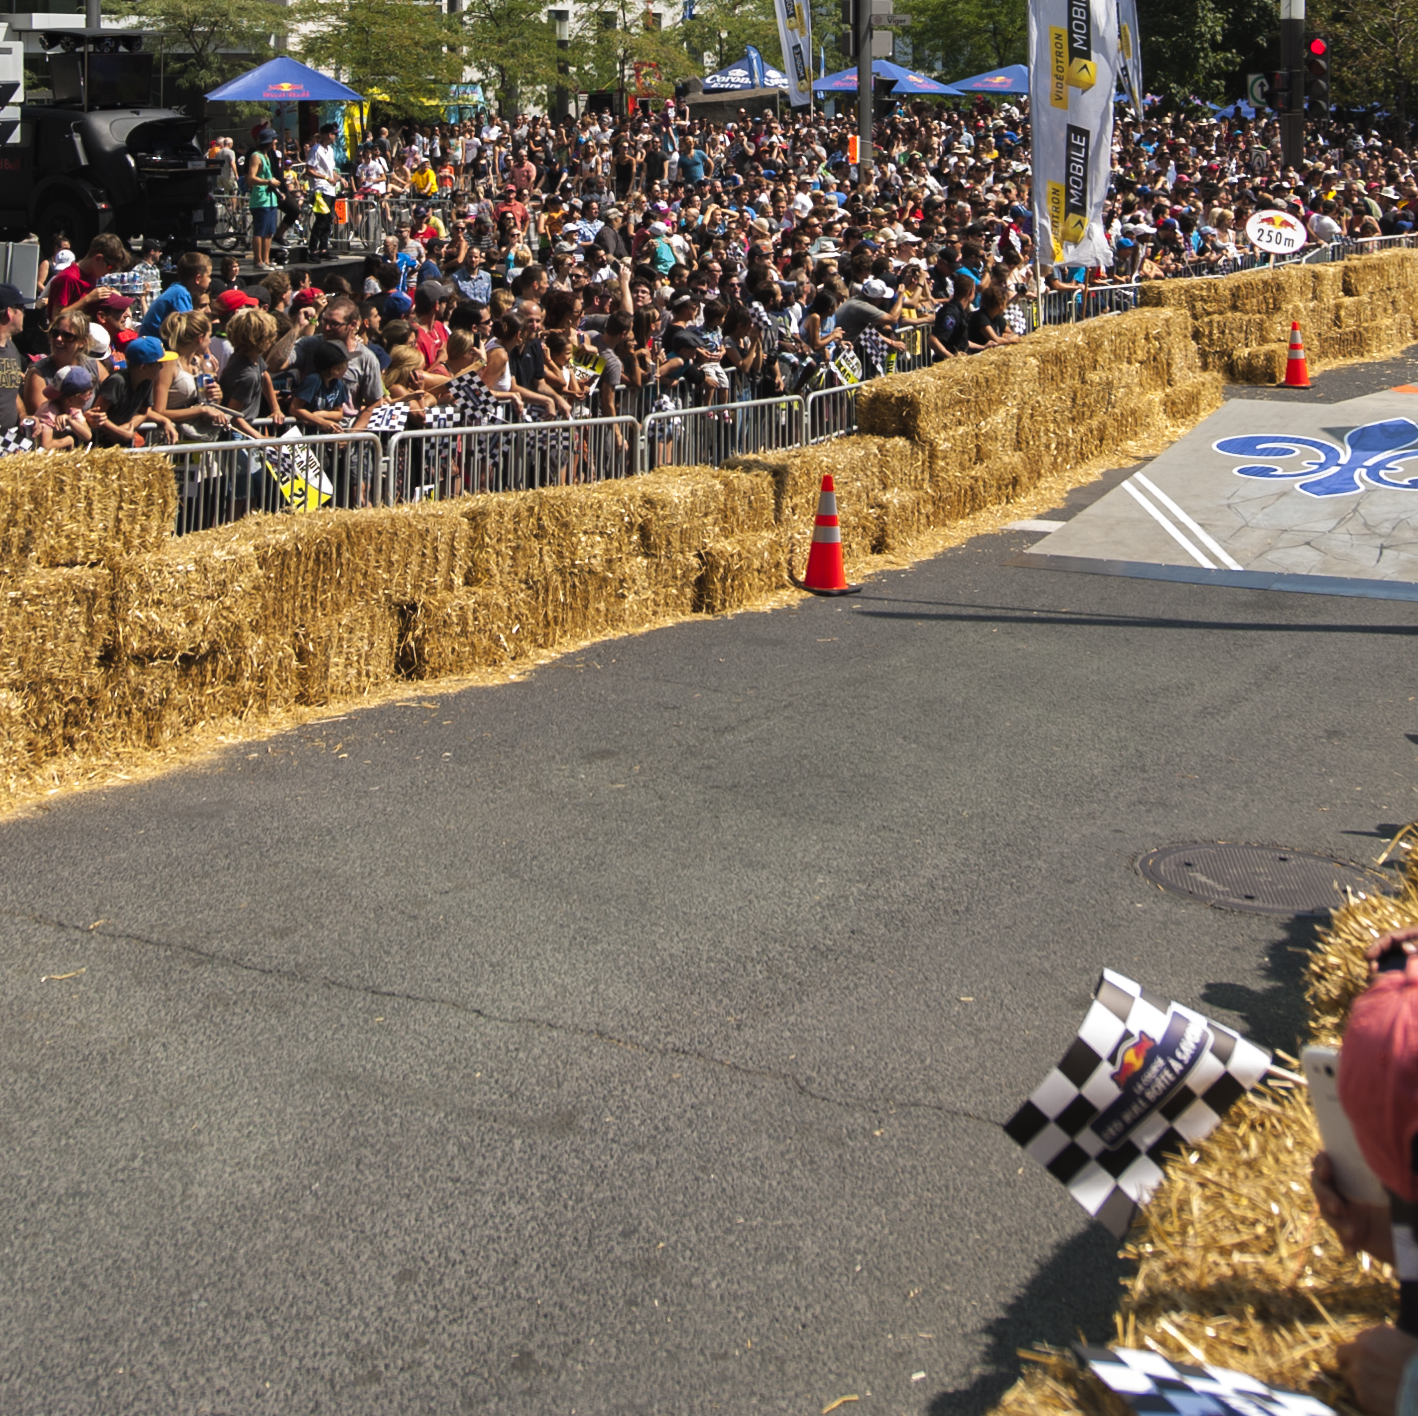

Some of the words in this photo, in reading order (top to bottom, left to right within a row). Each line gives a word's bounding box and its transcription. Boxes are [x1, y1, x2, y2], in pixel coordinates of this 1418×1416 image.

[887, 17, 907, 25] Viger
[1054, 32, 1063, 102] VIDÉOTRON
[705, 74, 752, 84] Coron
[1069, 133, 1087, 206] MOBILE
[1257, 228, 1294, 248] 250m
